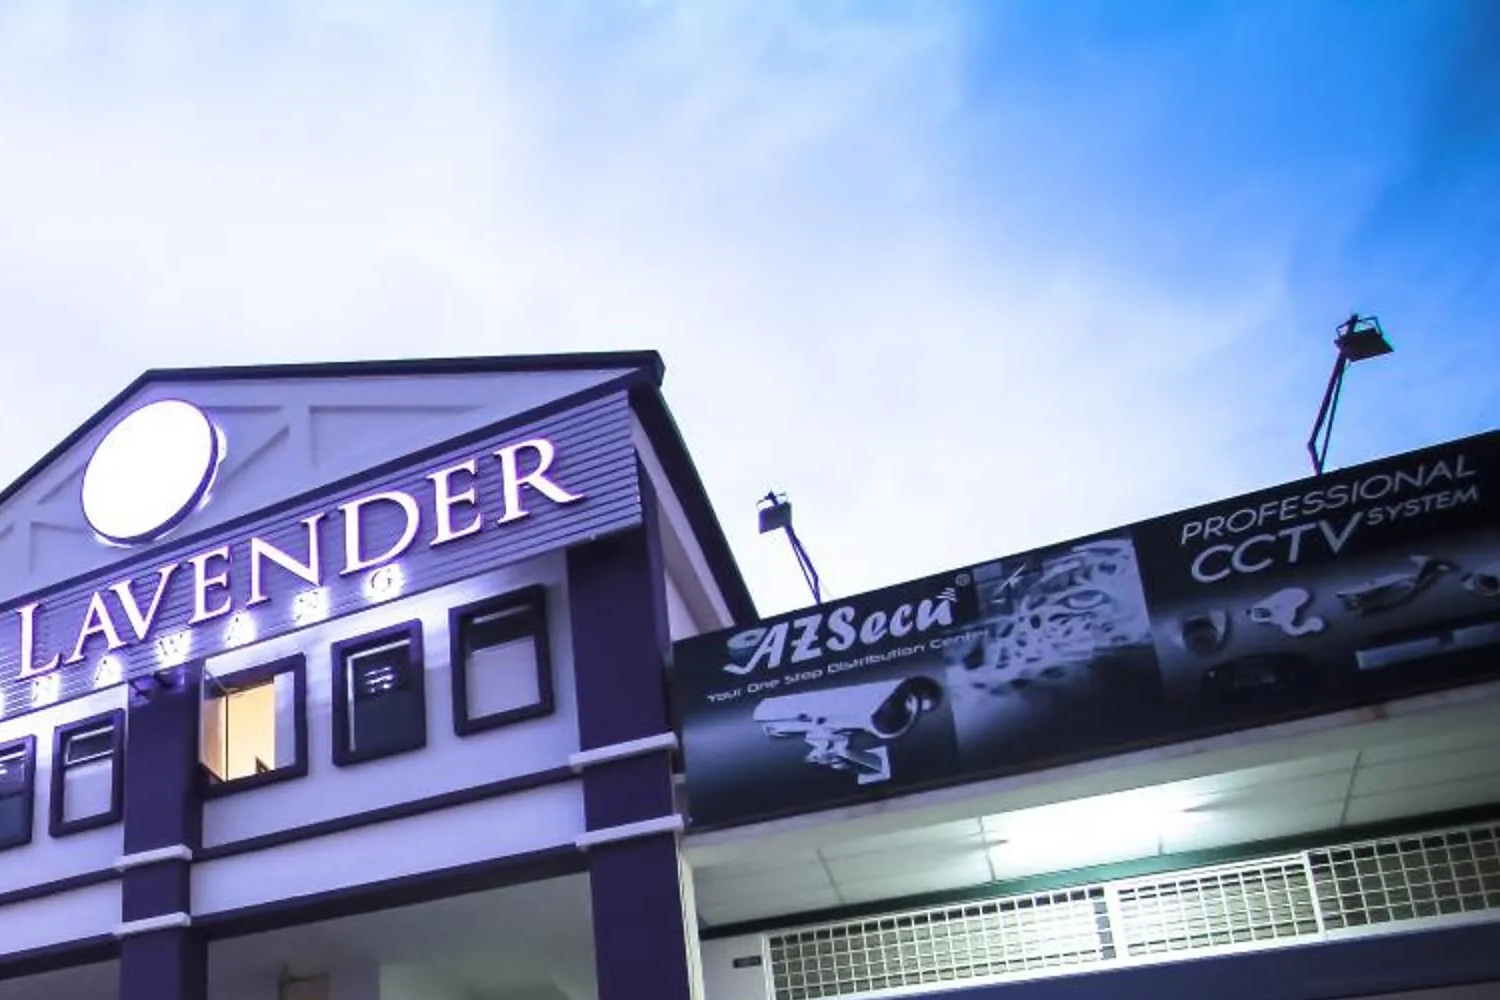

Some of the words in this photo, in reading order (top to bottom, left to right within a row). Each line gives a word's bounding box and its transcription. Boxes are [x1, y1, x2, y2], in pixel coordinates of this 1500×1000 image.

[1180, 455, 1477, 545] PROFESSIONAL
[1191, 511, 1364, 583] CCTV
[1366, 485, 1479, 526] SYSTEM
[13, 435, 584, 682] LAVENDER
[707, 687, 742, 703] Your
[747, 679, 780, 694] One
[784, 669, 823, 686] Stop
[827, 644, 926, 674] Distribution
